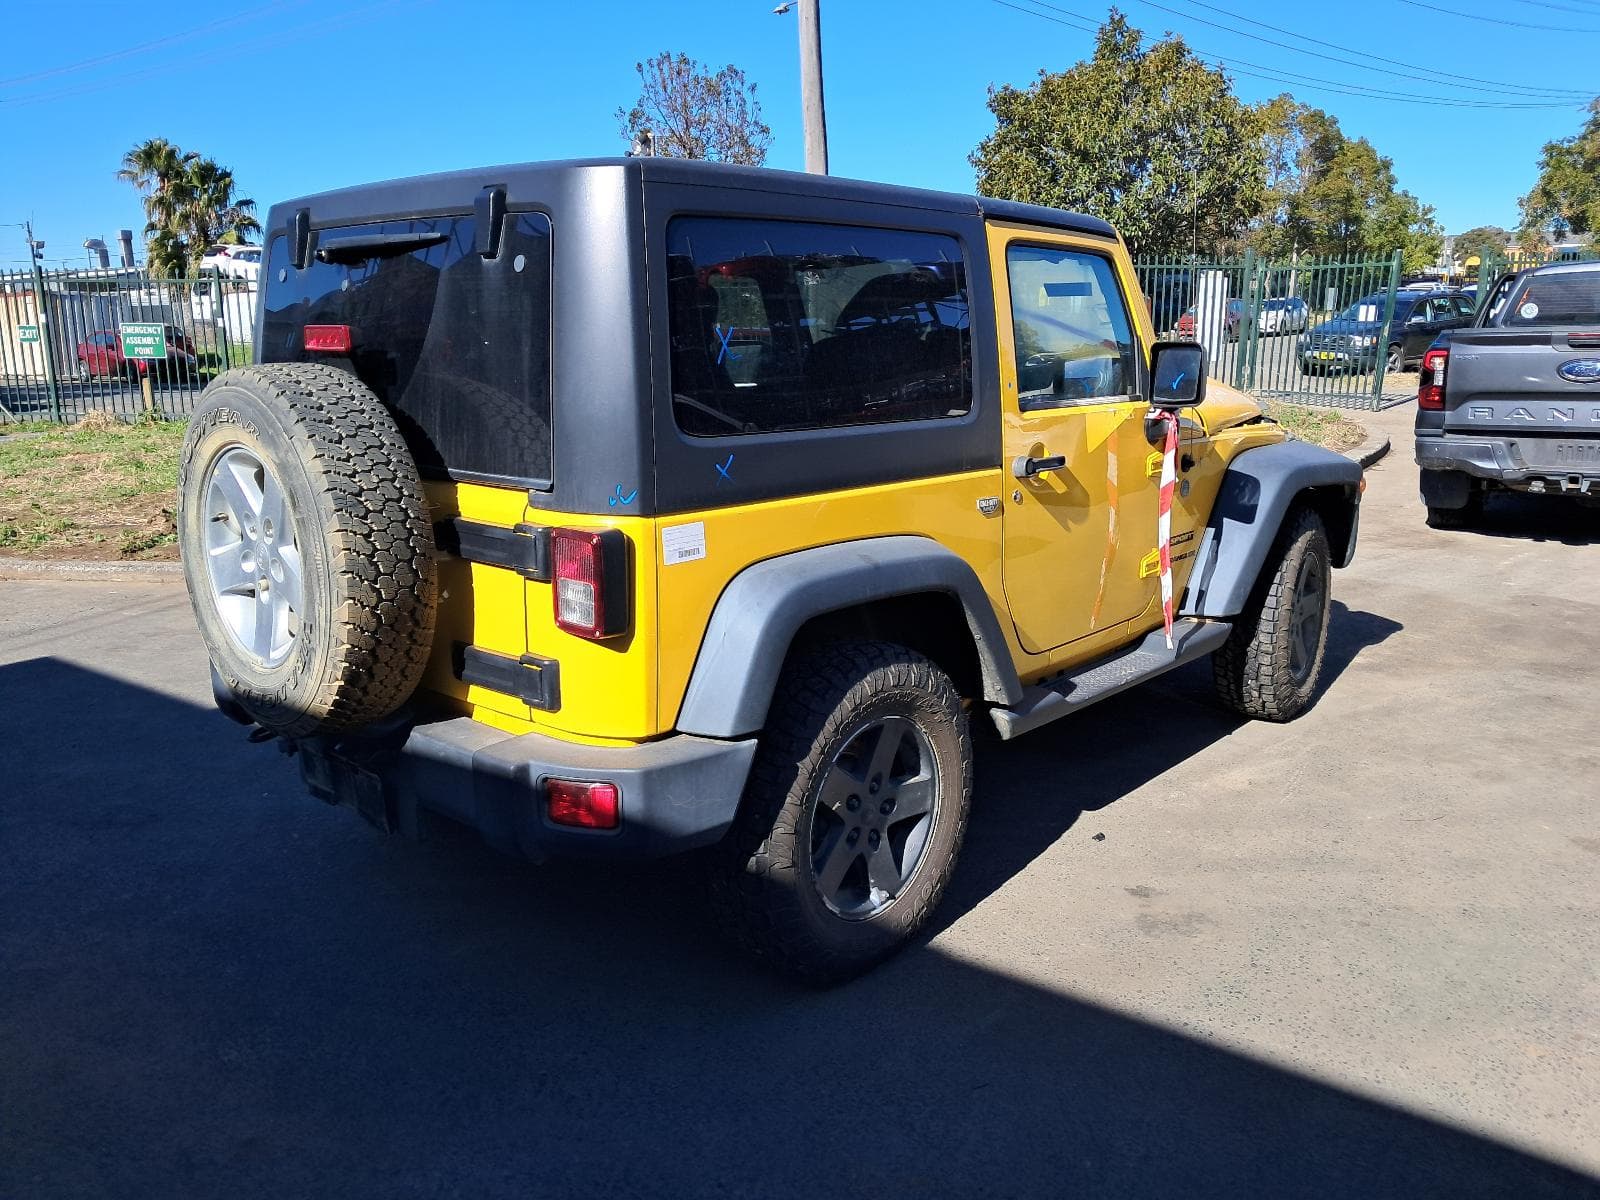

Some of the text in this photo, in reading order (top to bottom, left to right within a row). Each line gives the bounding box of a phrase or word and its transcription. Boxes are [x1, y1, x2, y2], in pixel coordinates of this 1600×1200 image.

[19, 329, 38, 339] EXIT
[122, 325, 161, 334] EMERGENCY
[126, 336, 160, 345] ASSEMBLY
[134, 346, 154, 355] POINT
